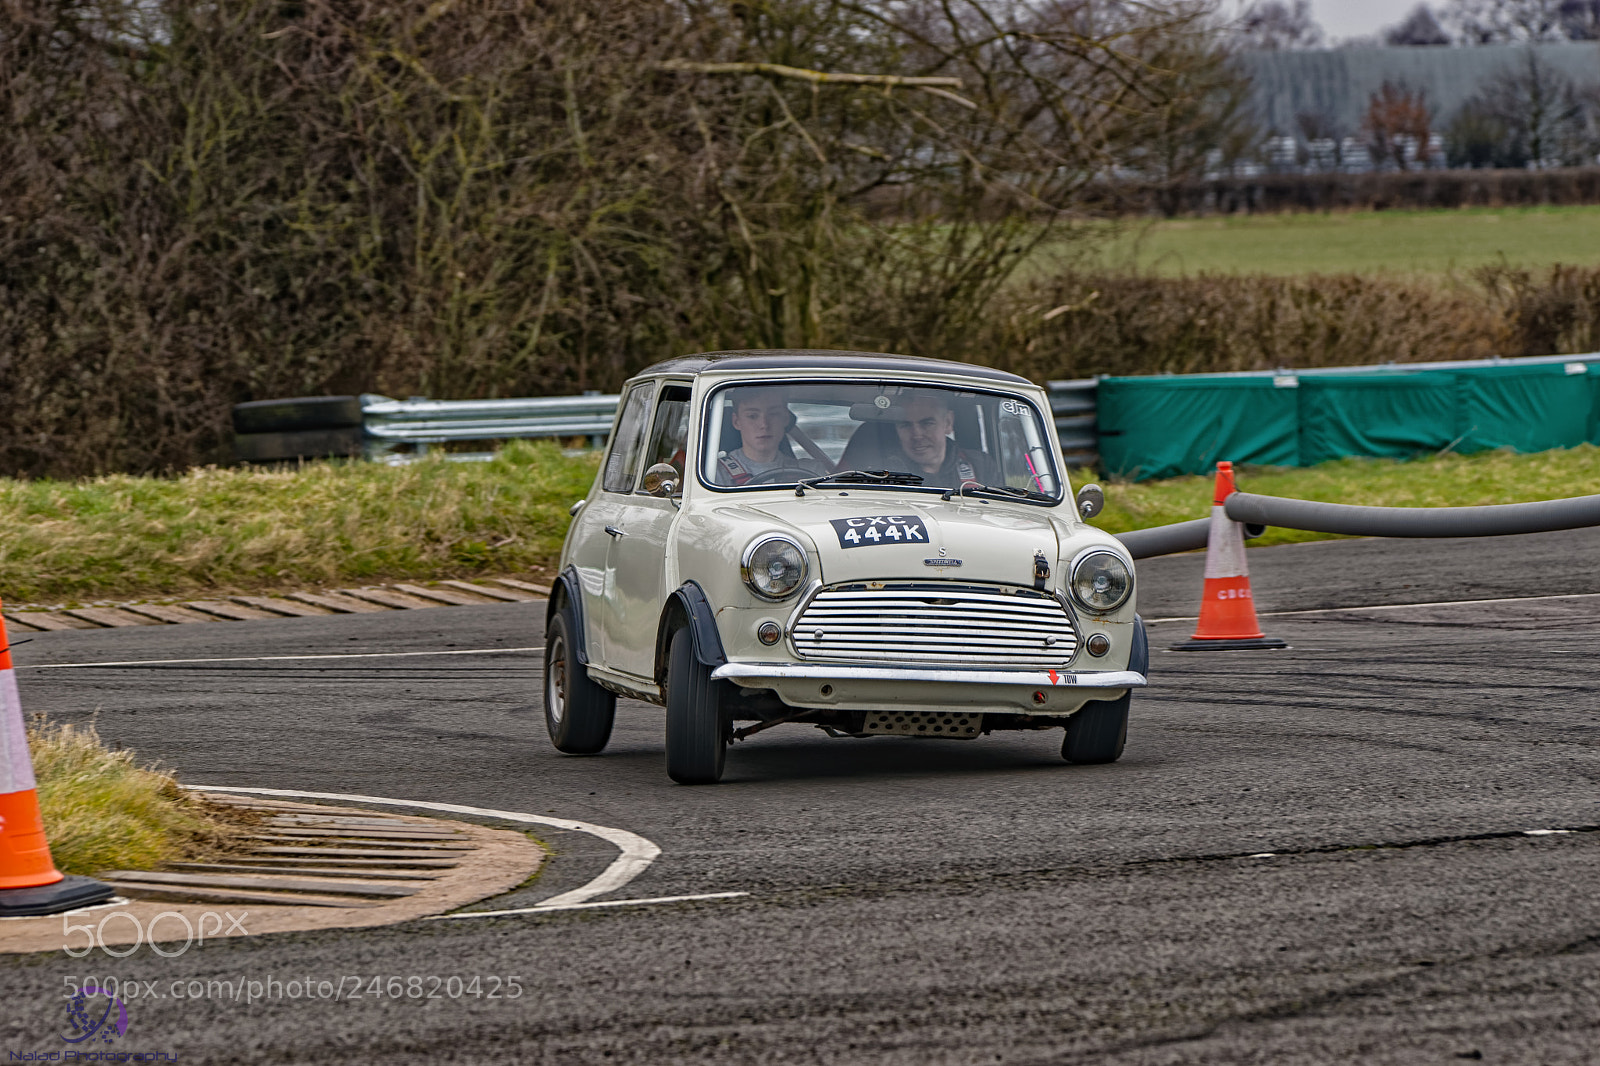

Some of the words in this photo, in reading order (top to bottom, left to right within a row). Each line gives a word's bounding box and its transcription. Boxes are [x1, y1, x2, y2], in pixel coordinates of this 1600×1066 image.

[846, 516, 906, 527] CXC
[844, 524, 923, 544] 444K
[939, 546, 947, 557] S
[1063, 674, 1077, 684] TOW
